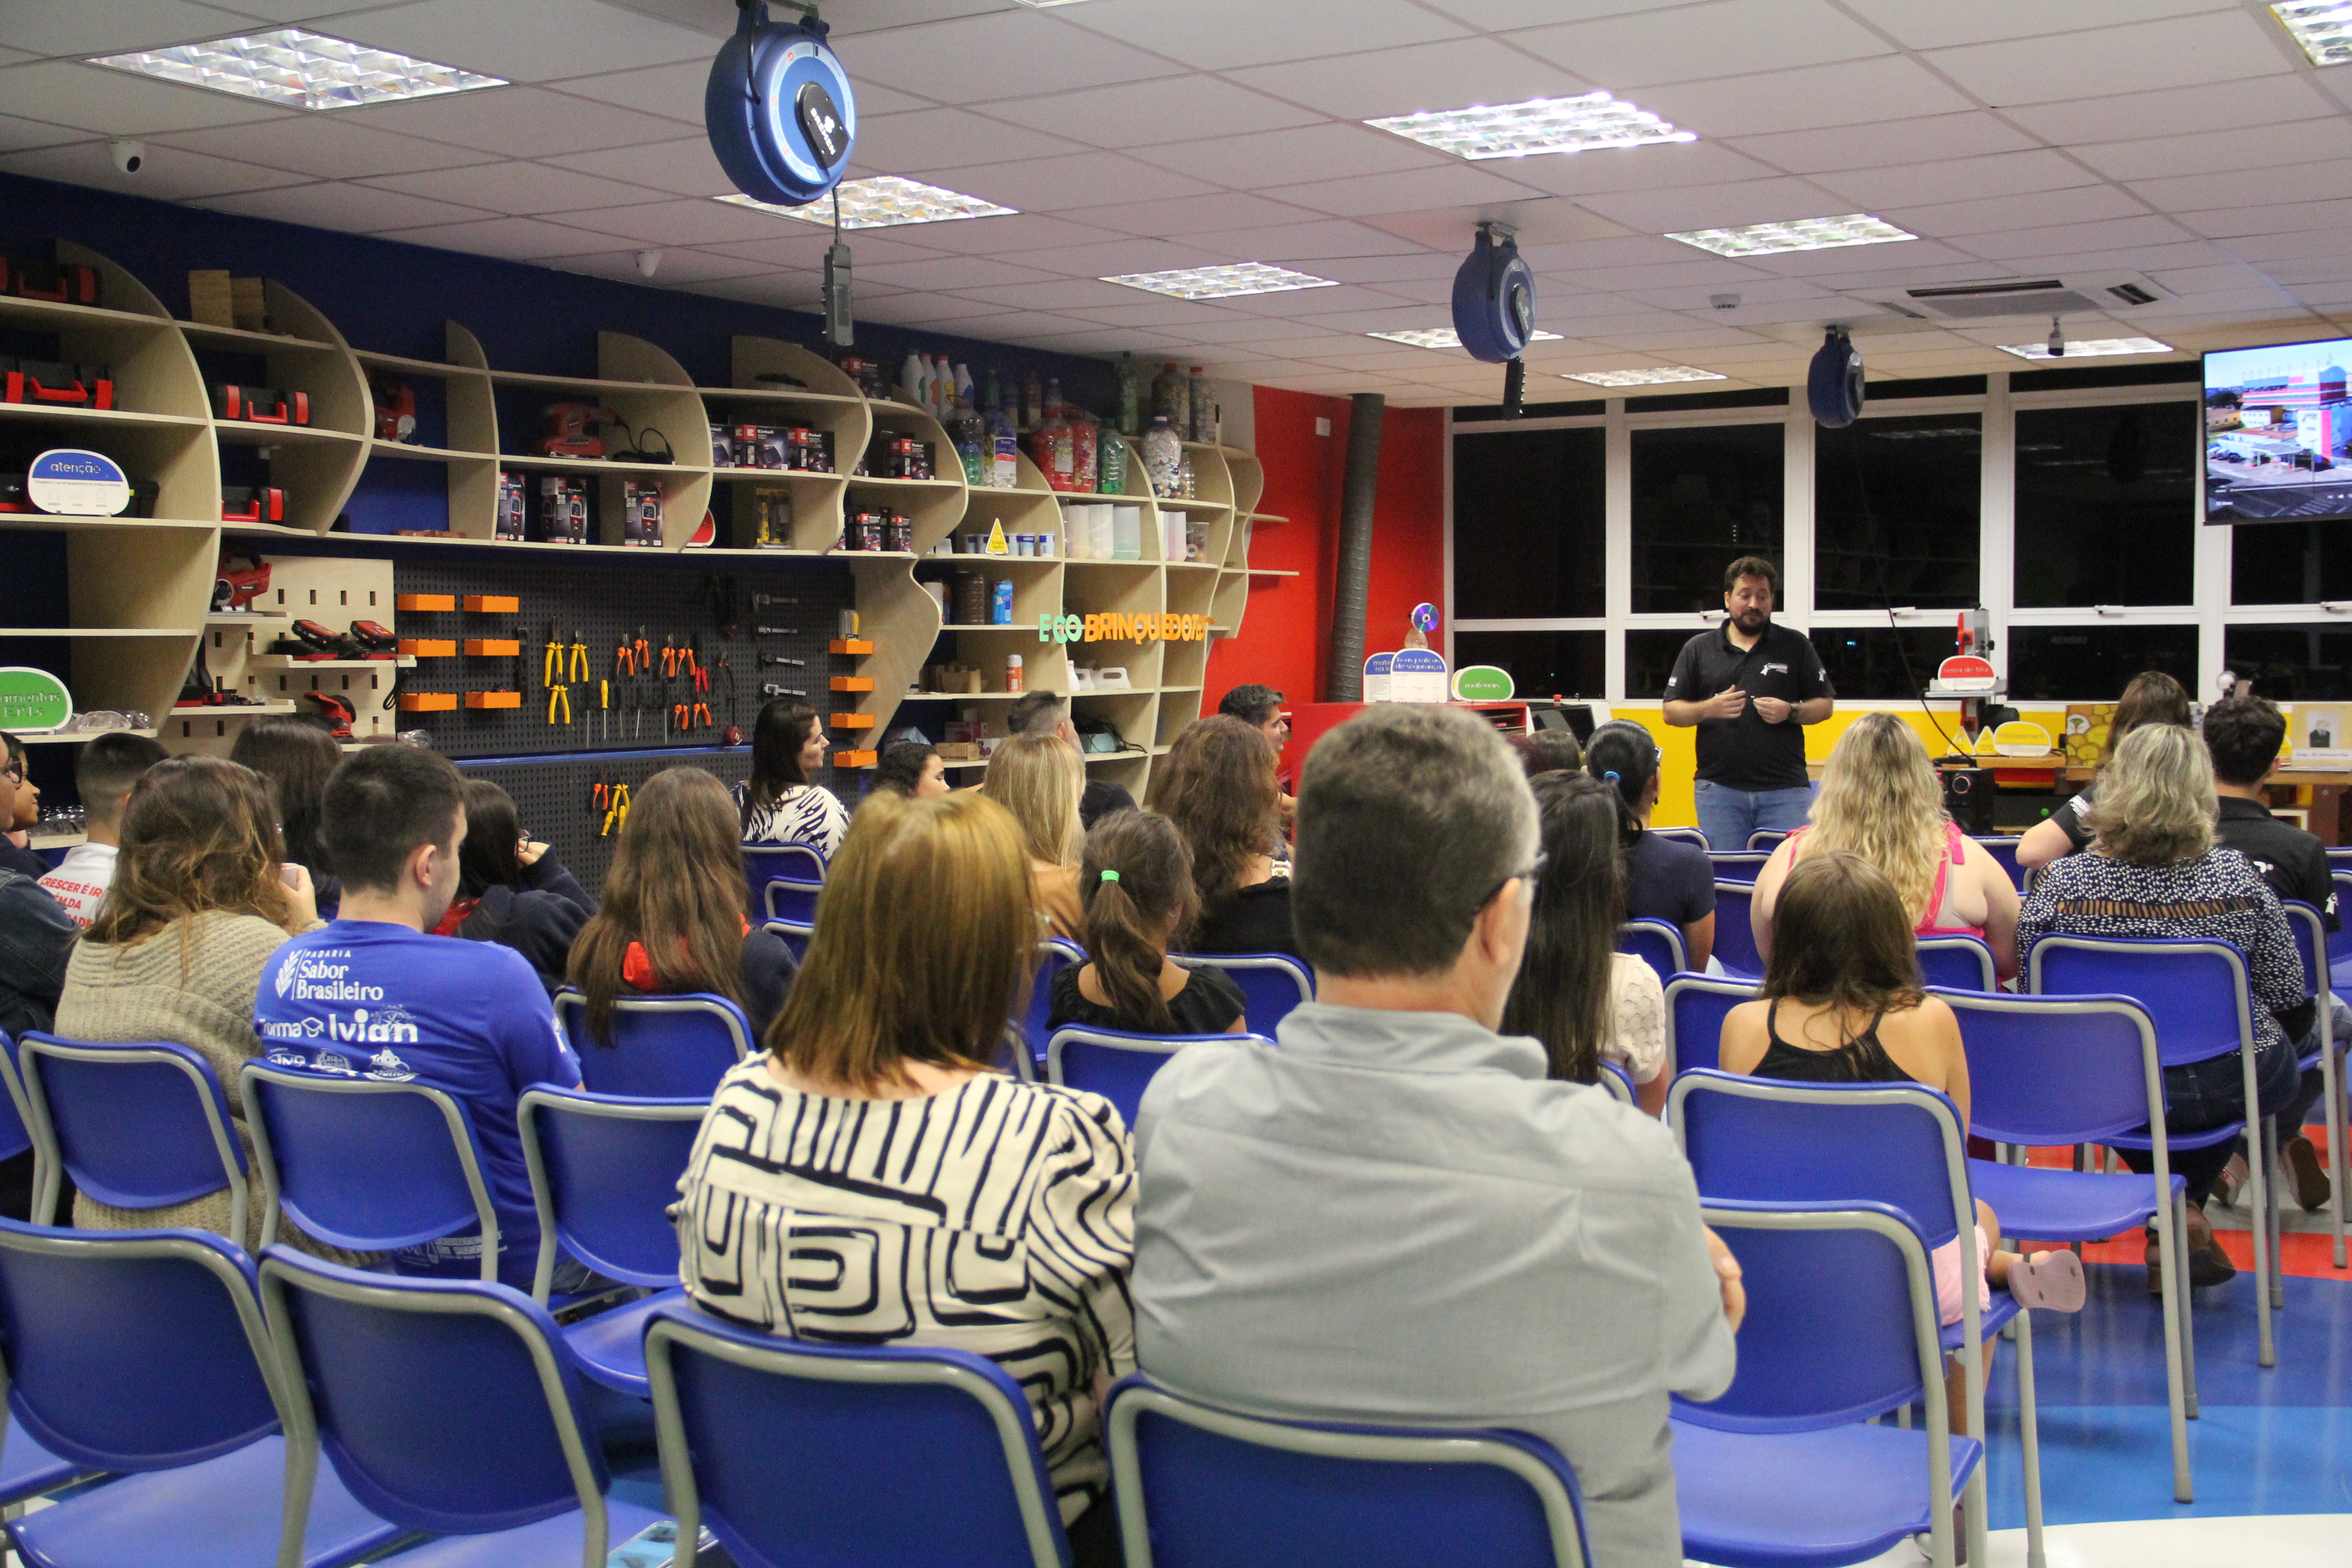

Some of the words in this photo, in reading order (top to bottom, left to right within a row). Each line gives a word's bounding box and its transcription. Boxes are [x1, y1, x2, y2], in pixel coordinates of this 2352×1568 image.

[810, 108, 836, 155] BREMEN
[50, 461, 102, 475] atenção
[40, 877, 81, 893] CRESCER
[80, 882, 90, 894] É
[88, 887, 103, 898] IR
[67, 898, 81, 910] DA
[304, 950, 351, 958] PADARIA
[298, 960, 349, 979] Sabor
[296, 980, 384, 1001] Brasileiro
